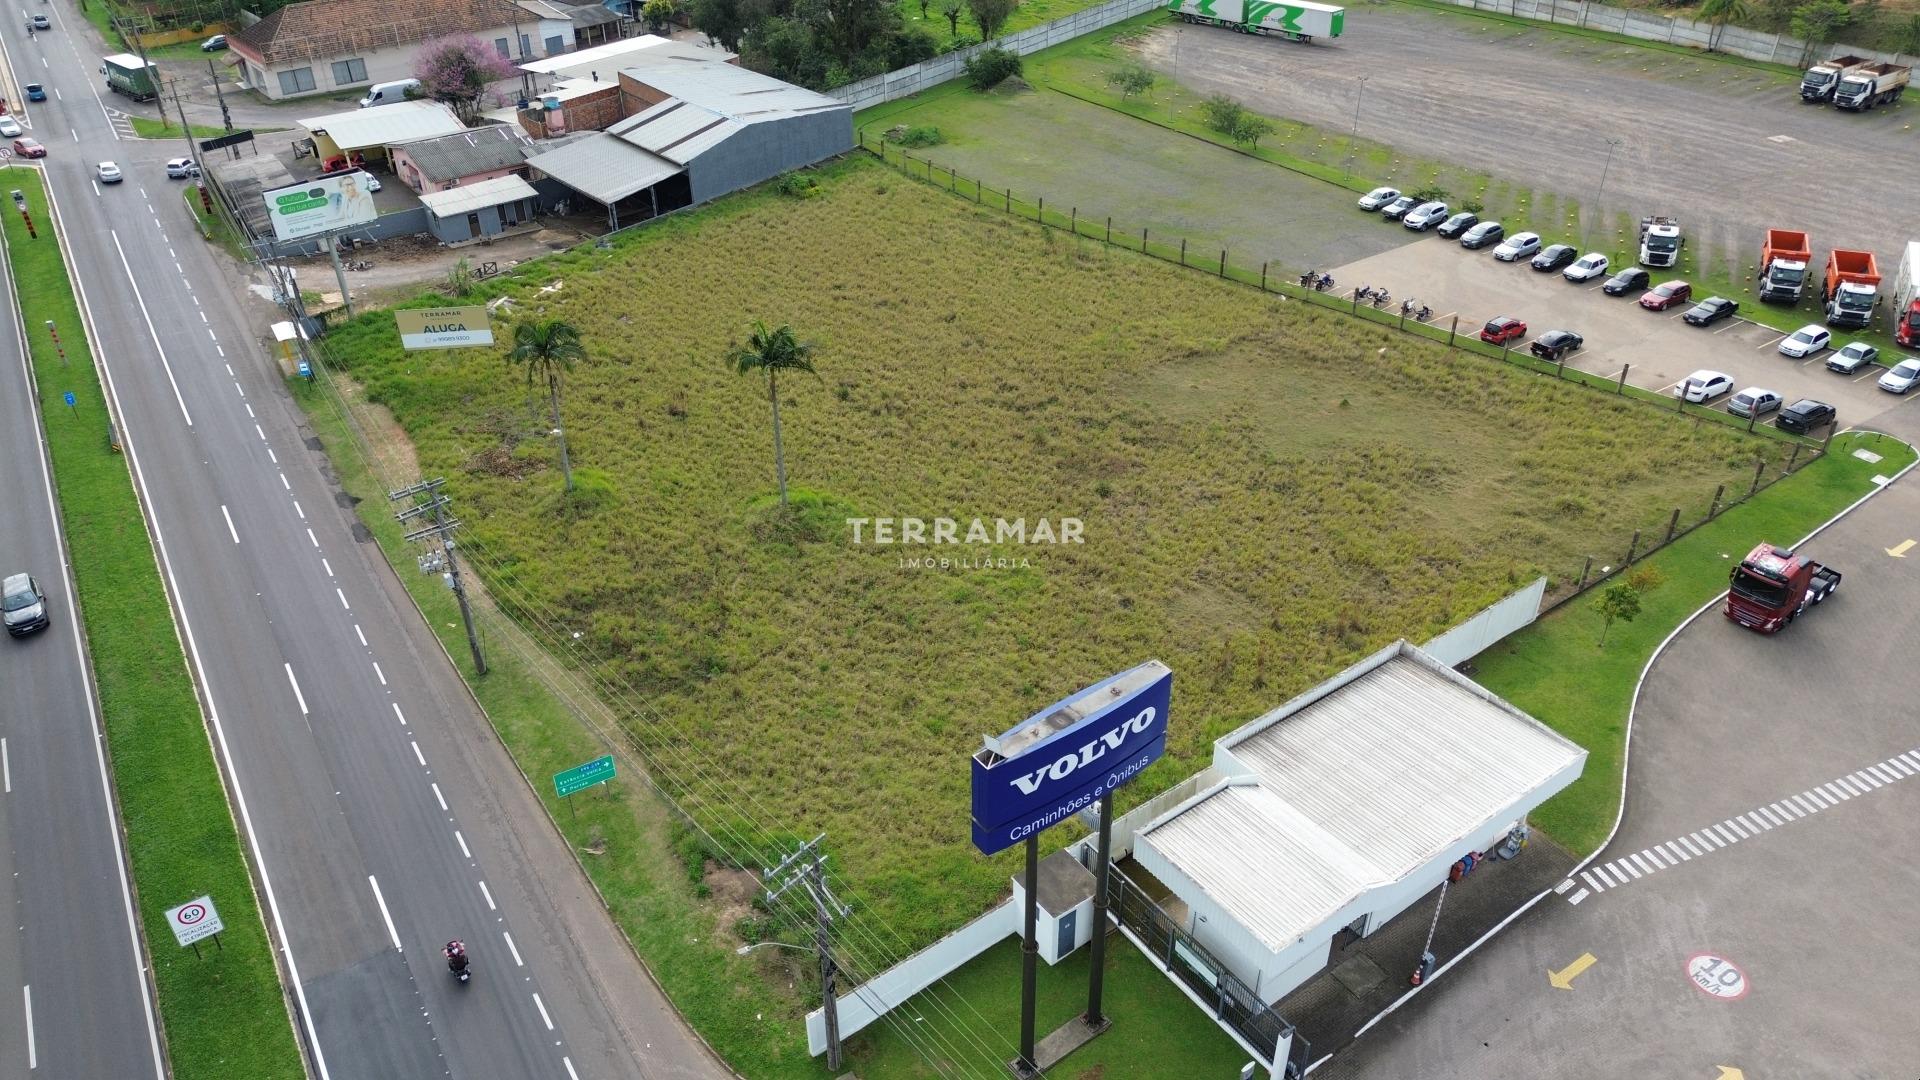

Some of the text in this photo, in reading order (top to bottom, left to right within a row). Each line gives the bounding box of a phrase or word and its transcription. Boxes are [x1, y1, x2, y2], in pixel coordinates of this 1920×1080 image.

[420, 310, 463, 318] TERRAMAR
[424, 323, 467, 334] ALUGA
[1010, 706, 1156, 796] VOLVO
[1010, 754, 1149, 841] Caminhões e Ônibus
[184, 908, 200, 920] 60
[178, 920, 218, 938] FISCALIZAÇÃO
[1691, 970, 1722, 995] km/h
[1700, 958, 1741, 987] 10
